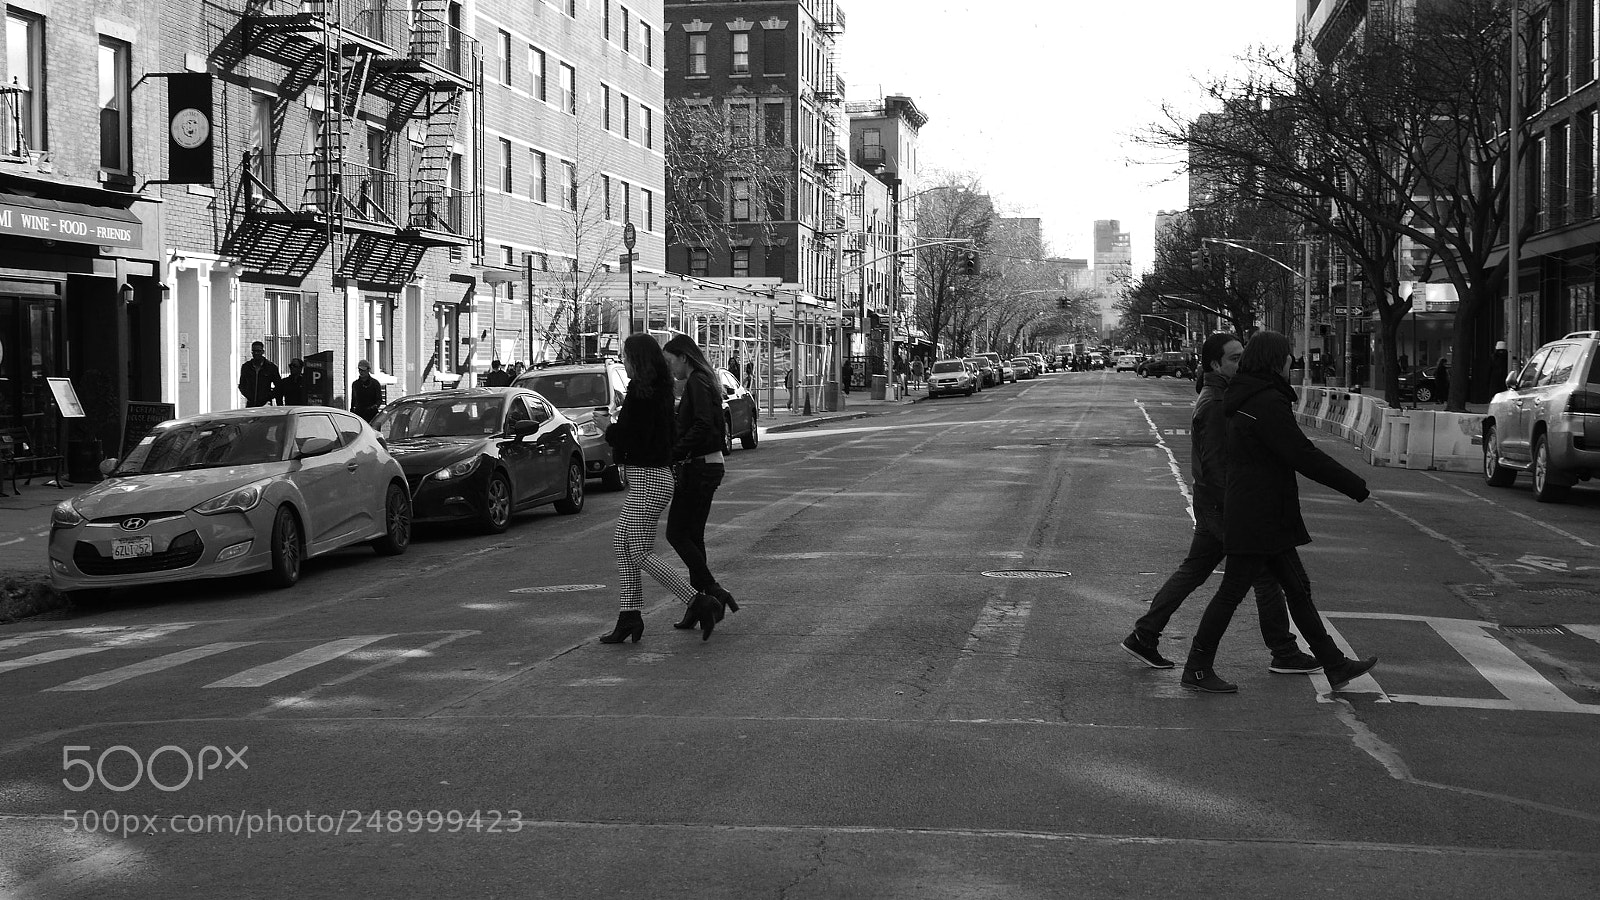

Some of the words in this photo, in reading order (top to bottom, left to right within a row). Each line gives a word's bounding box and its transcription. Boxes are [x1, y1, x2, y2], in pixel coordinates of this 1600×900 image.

[21, 213, 50, 232] WINE
[59, 219, 88, 236] FOOD
[97, 226, 131, 241] FRIENDS
[312, 371, 322, 385] P
